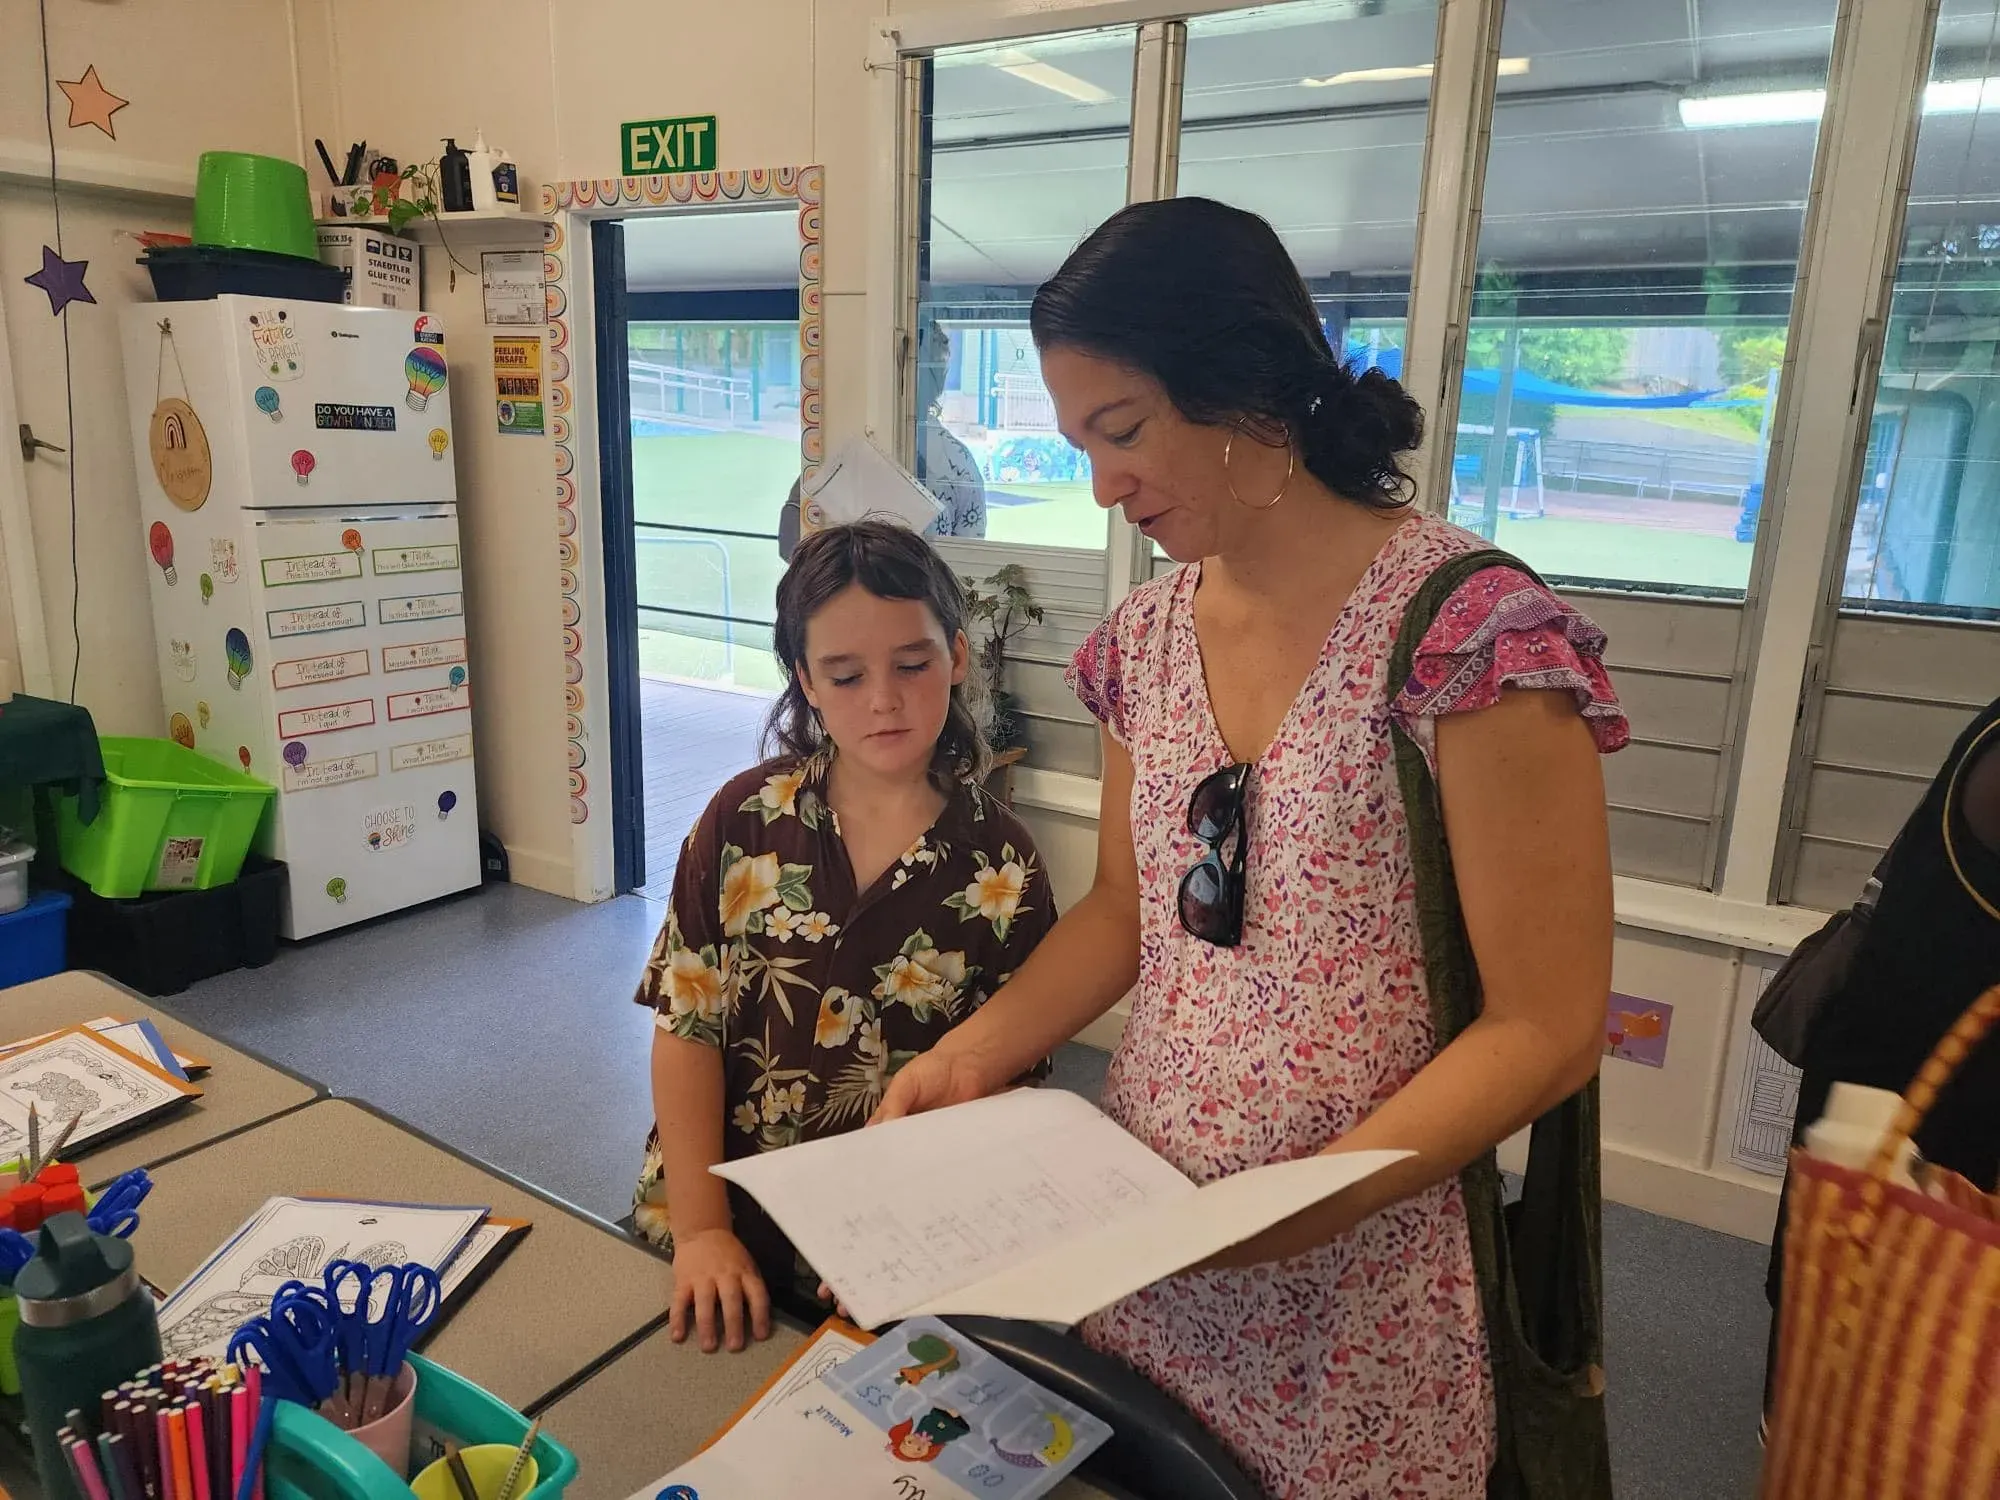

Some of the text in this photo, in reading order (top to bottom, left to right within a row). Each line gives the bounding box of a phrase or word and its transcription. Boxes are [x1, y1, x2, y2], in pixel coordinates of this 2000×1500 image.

[630, 122, 709, 170] EXIT
[368, 258, 411, 275] STAEDTLER
[367, 270, 411, 286] GLUE STICK
[252, 326, 294, 349] Future
[494, 346, 525, 355] FEELING
[317, 405, 393, 417] DO YOU HAVE A
[364, 806, 415, 829] CHOOSE TO
[382, 822, 416, 847] Shine
